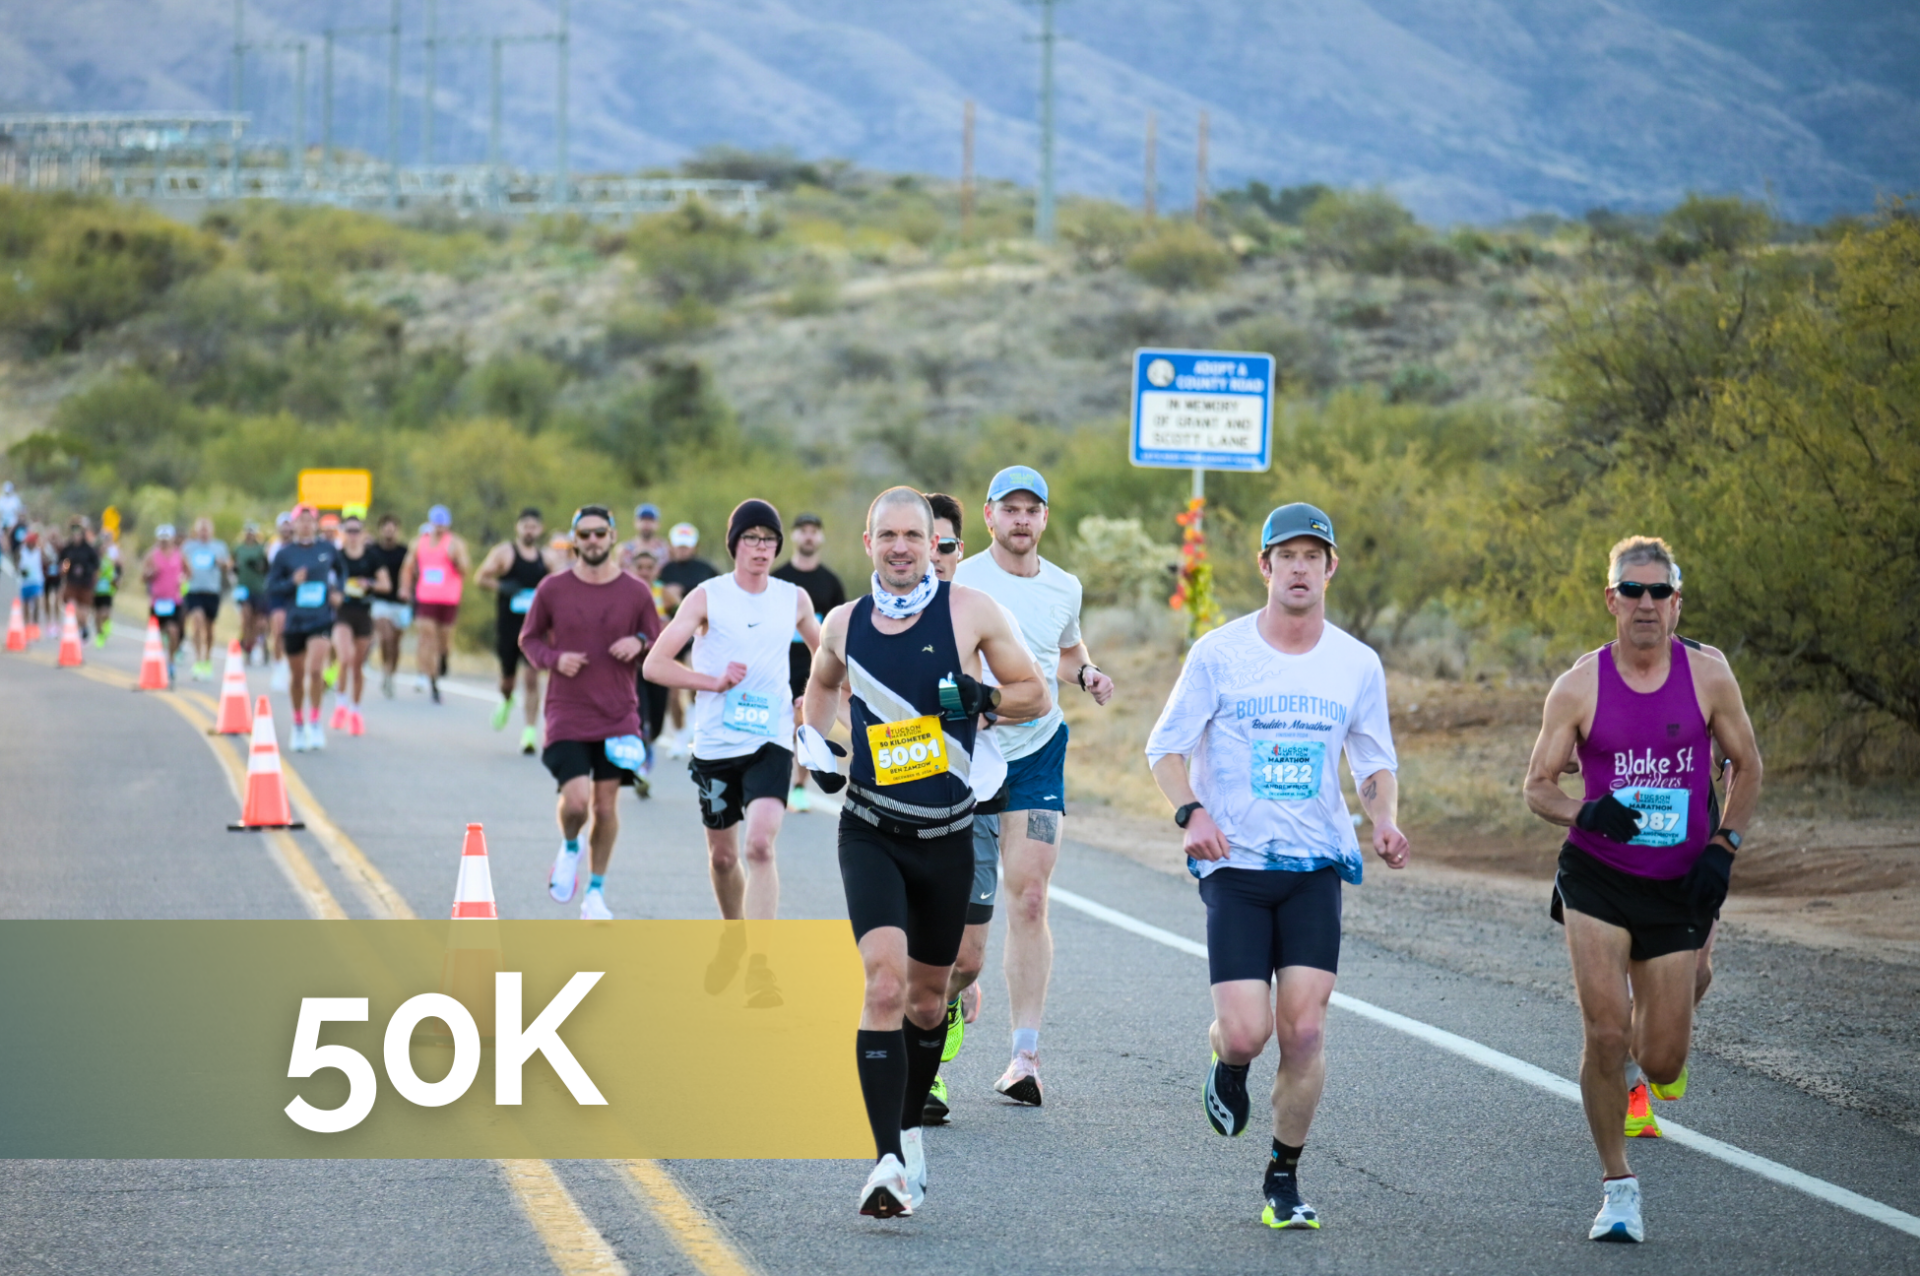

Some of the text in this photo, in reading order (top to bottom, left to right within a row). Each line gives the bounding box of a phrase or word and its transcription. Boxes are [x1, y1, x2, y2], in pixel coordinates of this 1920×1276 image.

[1193, 360, 1249, 378] ADOPT A
[1175, 374, 1265, 393] COUNTY ROAD
[1184, 399, 1238, 413] MEMORY
[1153, 414, 1252, 431] OF GRANT AND
[1153, 432, 1250, 449] SCOTT LANE
[734, 707, 770, 725] 509
[1236, 695, 1347, 726] BOULDERTHON
[891, 724, 921, 735] TUCSON
[1252, 718, 1333, 732] Boulder Marathon
[890, 732, 932, 746] KILOMETER
[891, 730, 922, 739] MARATHON
[878, 738, 941, 769] 5001
[1614, 746, 1695, 776] Blake St.
[904, 761, 932, 772] ZAMZOW
[1262, 764, 1313, 783] 1122
[1609, 771, 1682, 792] Striders
[1629, 803, 1672, 811] MARATHON
